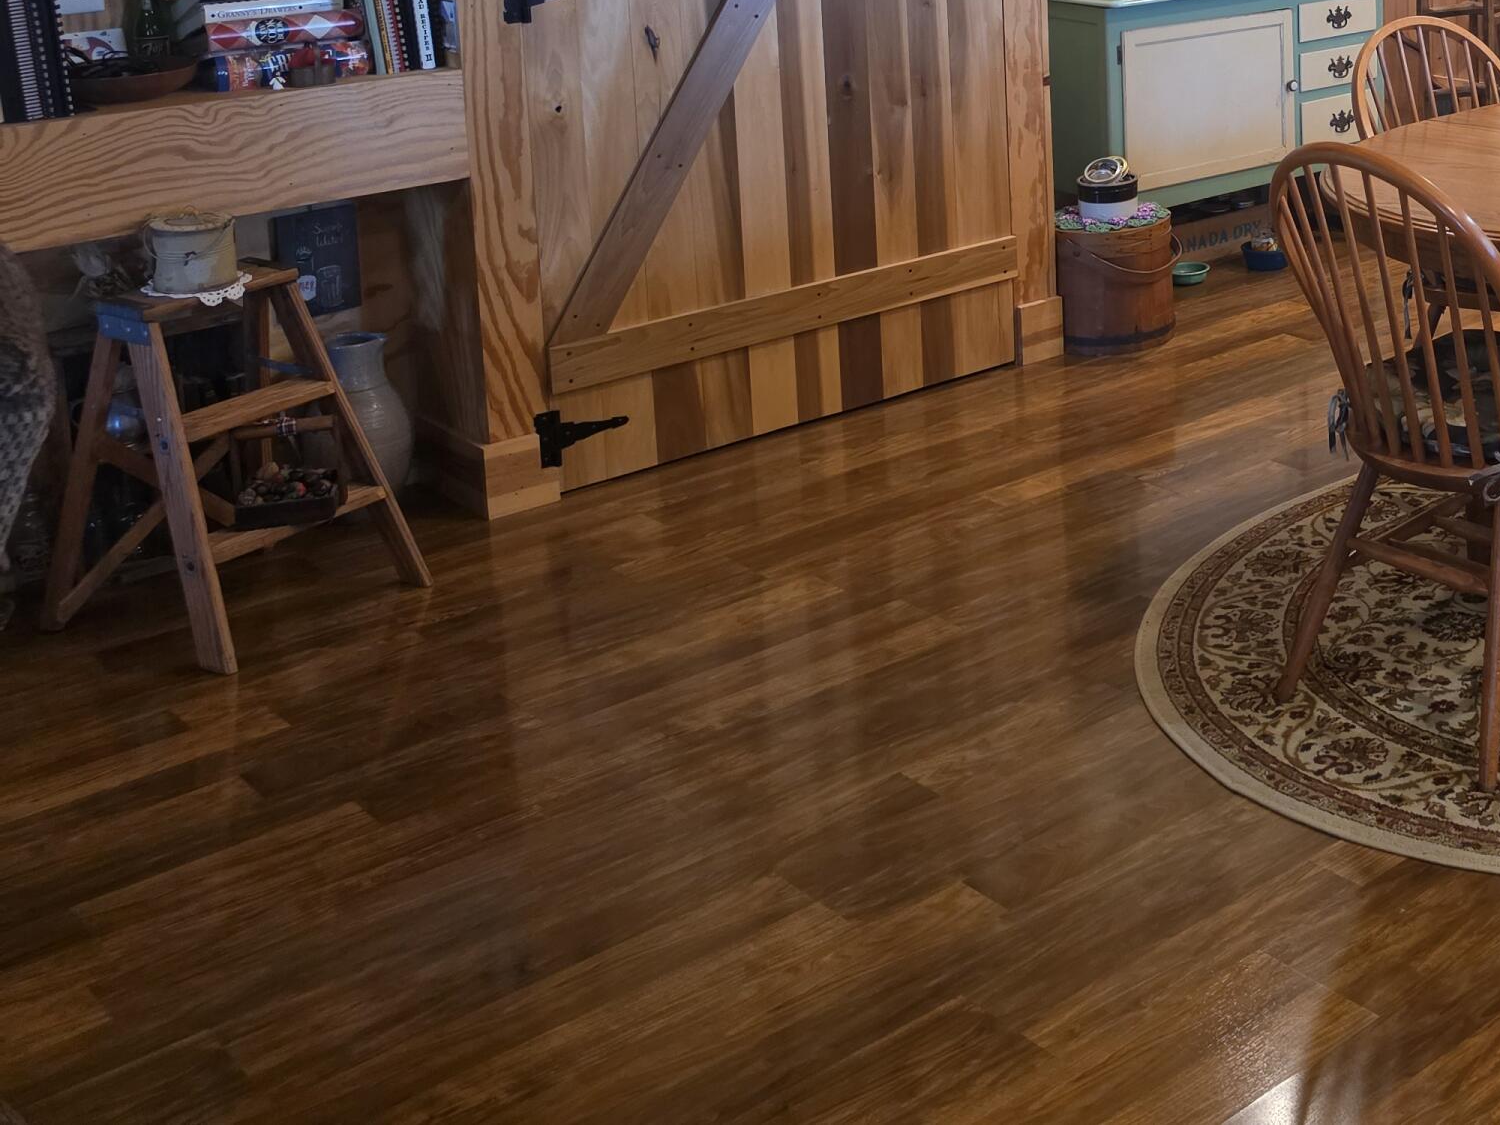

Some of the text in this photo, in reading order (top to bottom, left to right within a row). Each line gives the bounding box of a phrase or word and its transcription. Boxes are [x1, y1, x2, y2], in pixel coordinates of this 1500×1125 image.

[420, 13, 430, 51] RECIPES
[1182, 220, 1262, 252] NADA DRY
